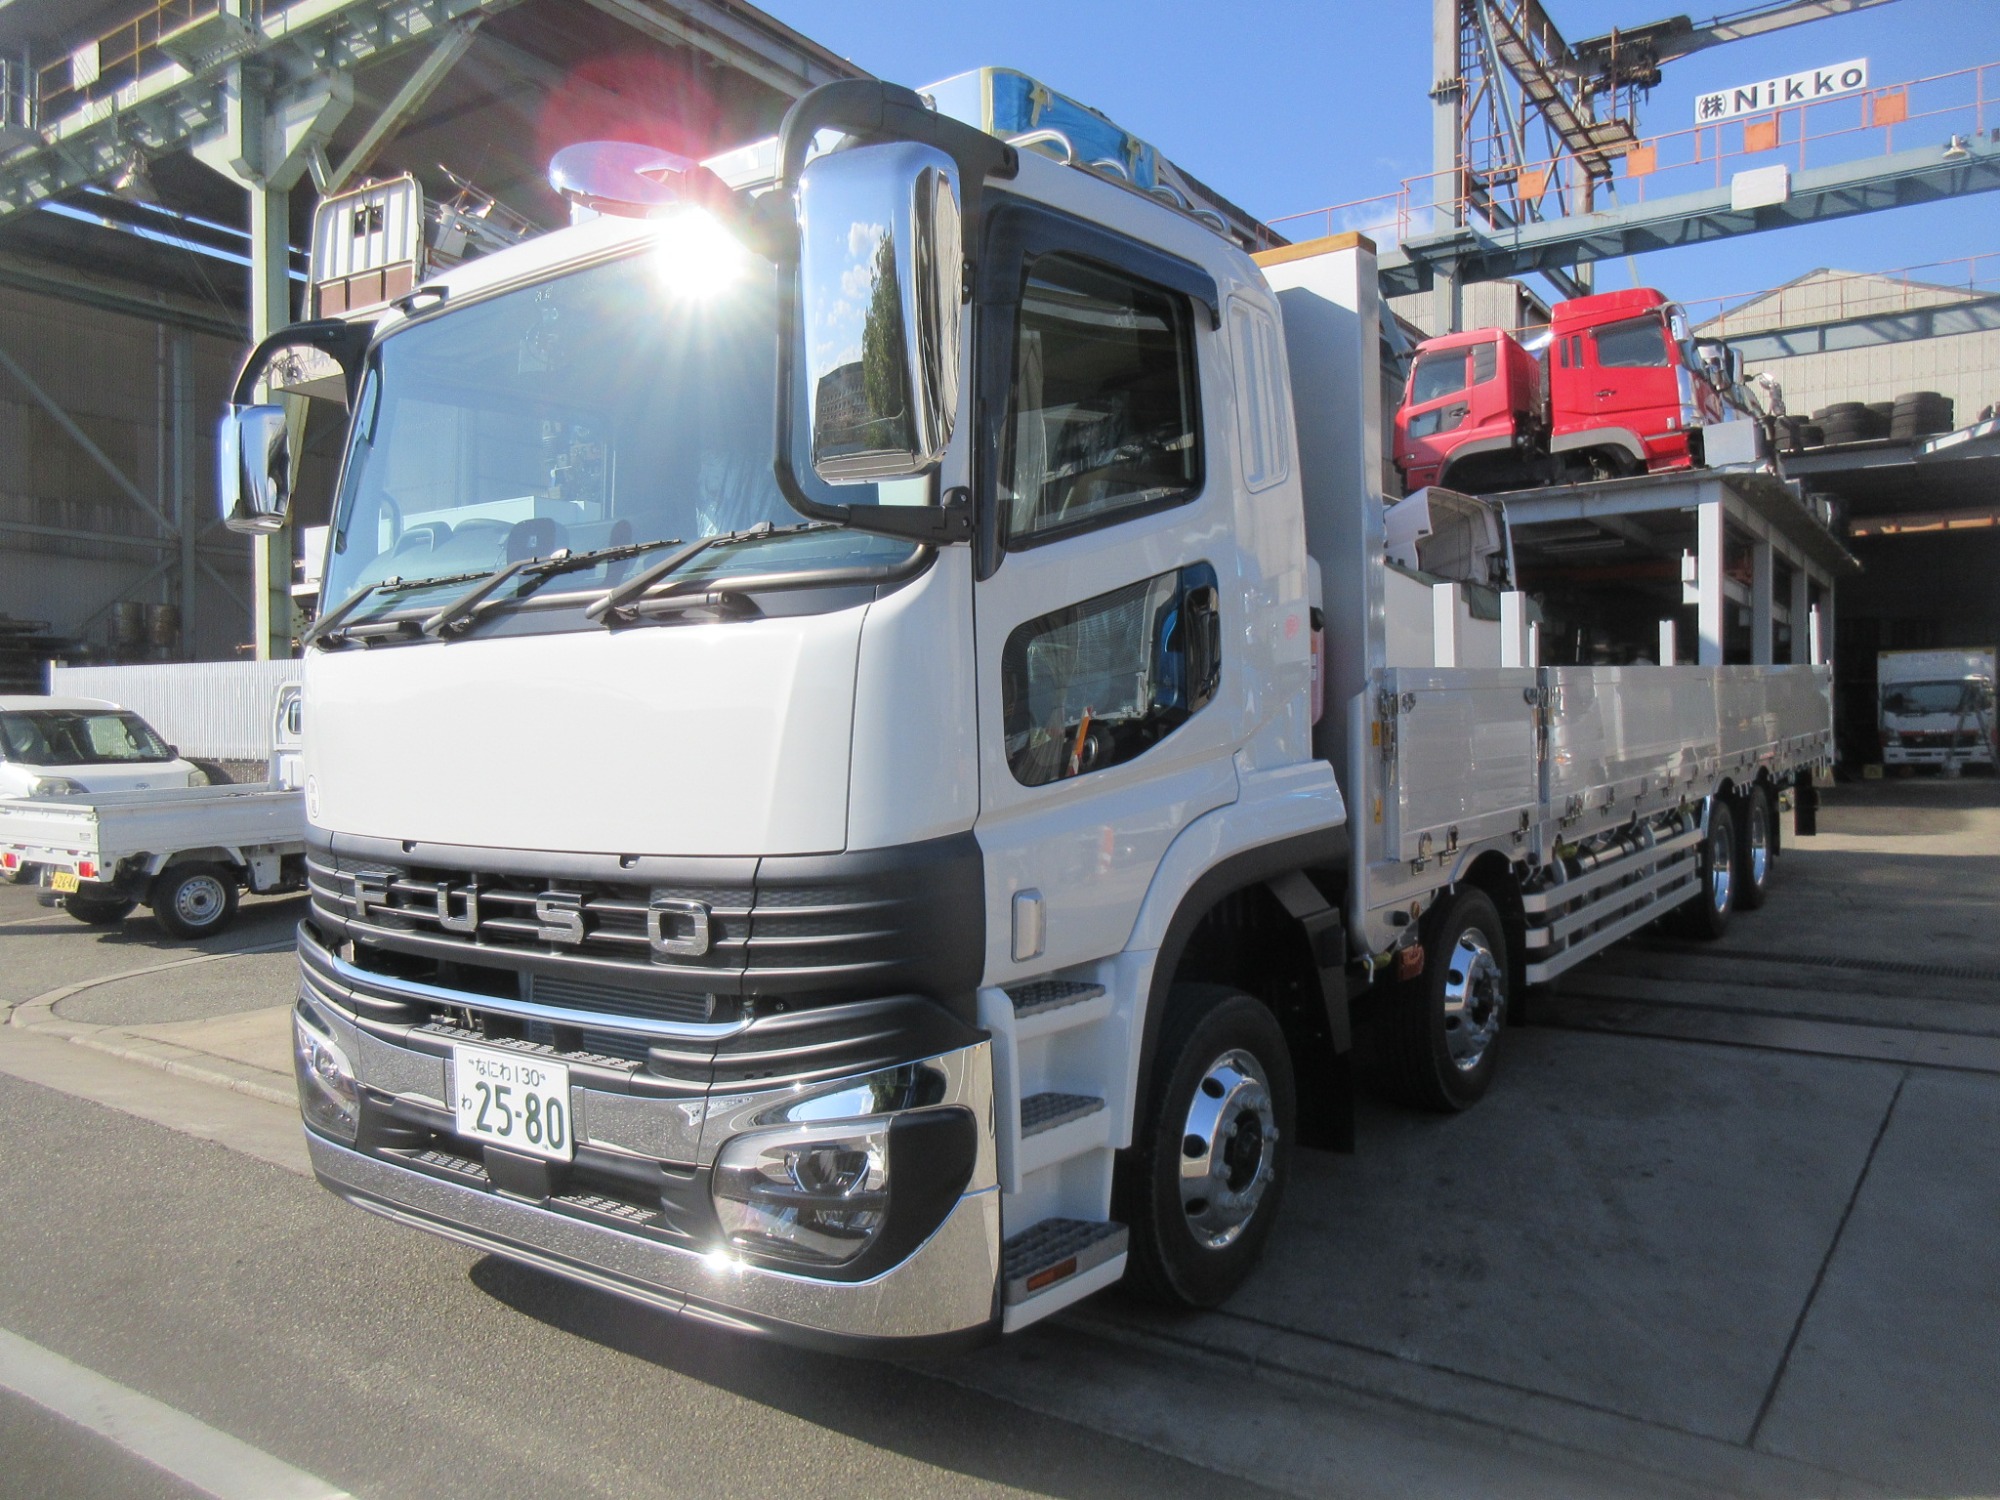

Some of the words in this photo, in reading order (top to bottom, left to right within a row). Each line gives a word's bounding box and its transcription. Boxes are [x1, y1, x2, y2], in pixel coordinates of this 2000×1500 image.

[1734, 68, 1863, 113] Nikko
[355, 870, 710, 956] FUSO
[461, 1093, 473, 1110] わ
[475, 1081, 565, 1150] 25-80
